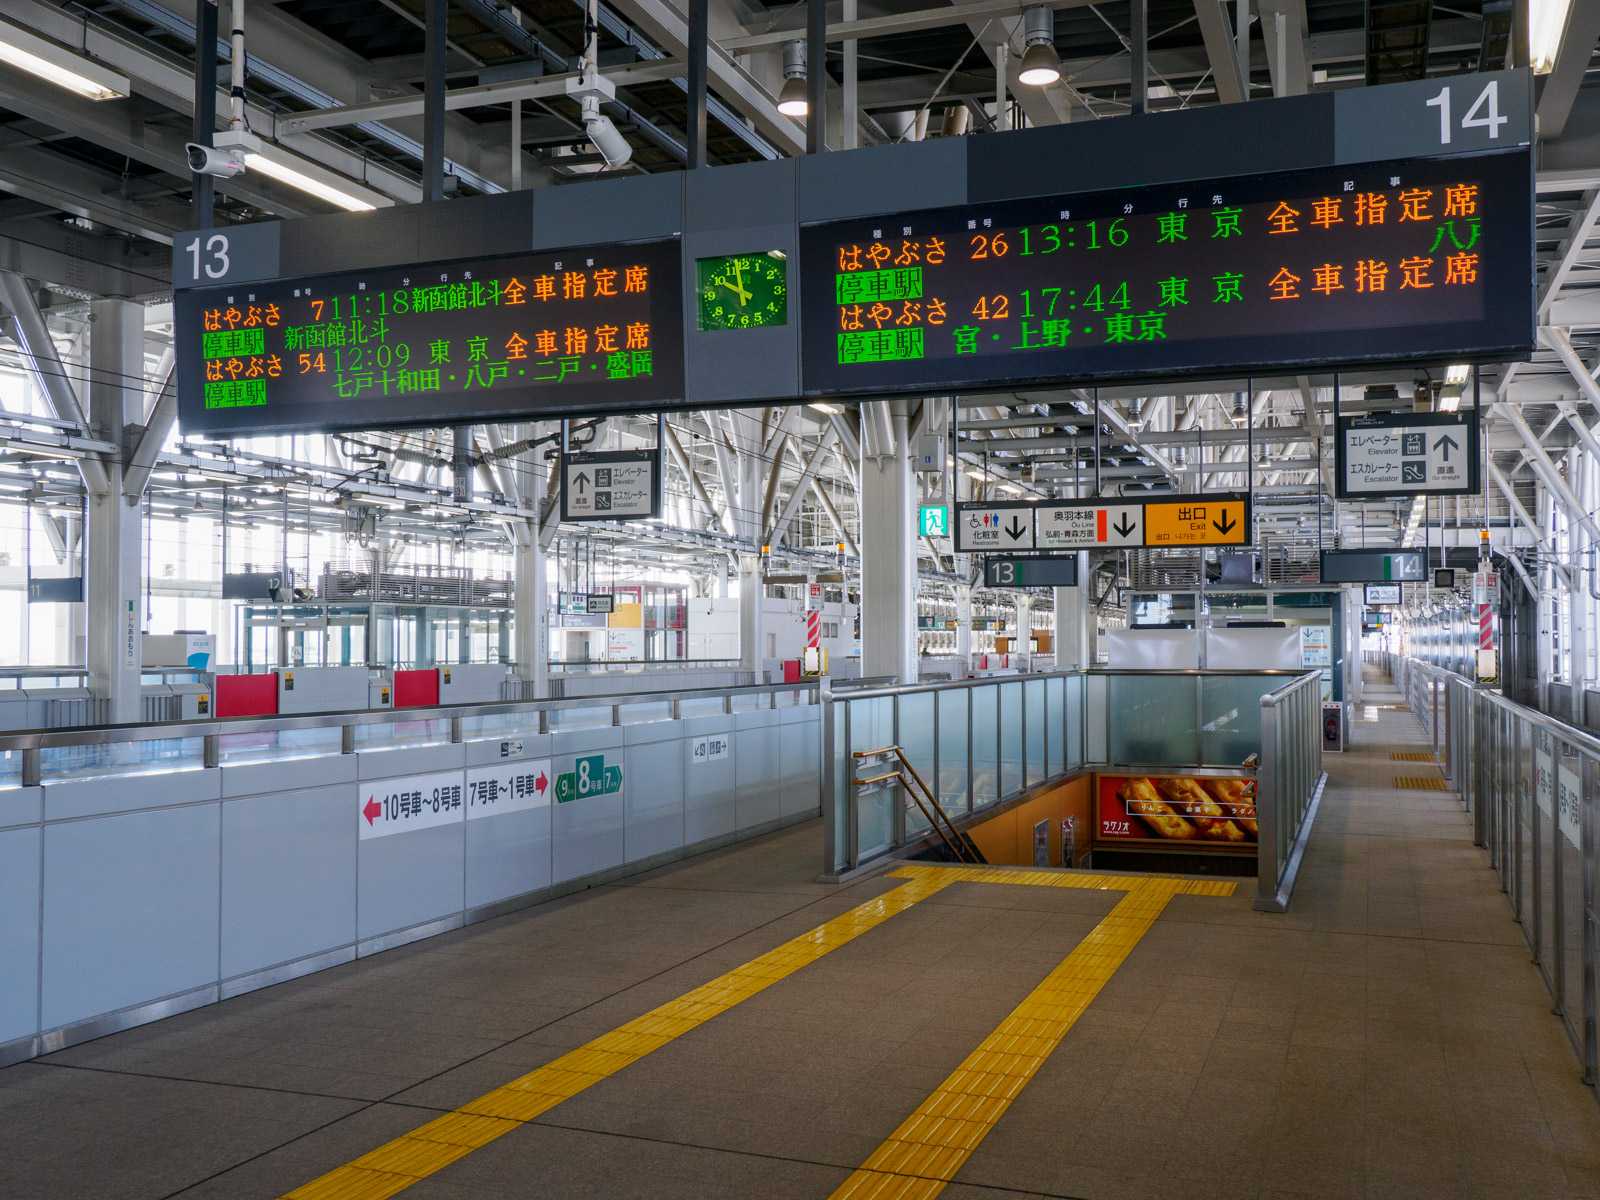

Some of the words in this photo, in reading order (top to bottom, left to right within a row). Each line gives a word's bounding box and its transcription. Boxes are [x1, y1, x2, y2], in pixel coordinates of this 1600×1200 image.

[1426, 80, 1507, 144] 14
[873, 226, 912, 239] 種別
[967, 218, 992, 230] 番号
[1060, 210, 1070, 220] 時
[1123, 203, 1133, 214] 分
[1178, 194, 1223, 209] 行先
[1343, 176, 1401, 192] 記事
[839, 237, 946, 271] はやぶさ
[970, 233, 1008, 260] 26
[1019, 218, 1129, 256] 13:16
[1156, 207, 1243, 243] 東京
[1267, 184, 1478, 235] 全車指定席
[186, 235, 229, 280] 13
[403, 278, 410, 286] 分
[441, 271, 472, 283] 行先
[555, 258, 594, 270] 記事
[754, 262, 760, 272] 1
[714, 276, 726, 286] 10
[766, 270, 775, 280] 2
[774, 285, 782, 295] 3
[837, 268, 922, 304] 停車駅
[841, 297, 947, 331] はやぶさ
[971, 295, 1009, 320] 42
[1020, 281, 1132, 318] 17:44
[1157, 272, 1244, 307] 東京
[1268, 252, 1478, 300] 全車指定席
[204, 303, 280, 331] はやぶさ
[311, 300, 324, 321] 7
[331, 290, 409, 320] 11:18
[412, 280, 503, 313] 新函館北斗
[504, 265, 648, 305] 全車指定席
[707, 291, 716, 301] 9
[715, 306, 723, 316] 8
[766, 302, 775, 311] 4
[727, 314, 736, 324] 7
[741, 315, 749, 325] 6
[754, 312, 762, 322] 5
[203, 328, 264, 359] 停車駅
[284, 318, 390, 351] 新函館北斗
[838, 327, 923, 363] 停車駅
[206, 354, 282, 381] はやぶさ
[299, 353, 326, 374] 54
[333, 343, 410, 372] 12:09
[429, 336, 488, 365] 東京
[505, 322, 649, 360] 全車指定席
[205, 379, 266, 409] 停車駅
[1350, 434, 1399, 447] エレベーター
[613, 467, 648, 477] エレベーター
[1350, 462, 1399, 474] エスカレーター
[613, 490, 648, 500] エスカレーター
[1054, 510, 1095, 520] 奥羽本線
[1178, 507, 1206, 521] 出口
[973, 530, 999, 539] 化粧室
[1175, 532, 1196, 540] 나가는
[1394, 555, 1421, 577] 14
[992, 562, 1014, 583] 13
[30, 584, 40, 596] 11
